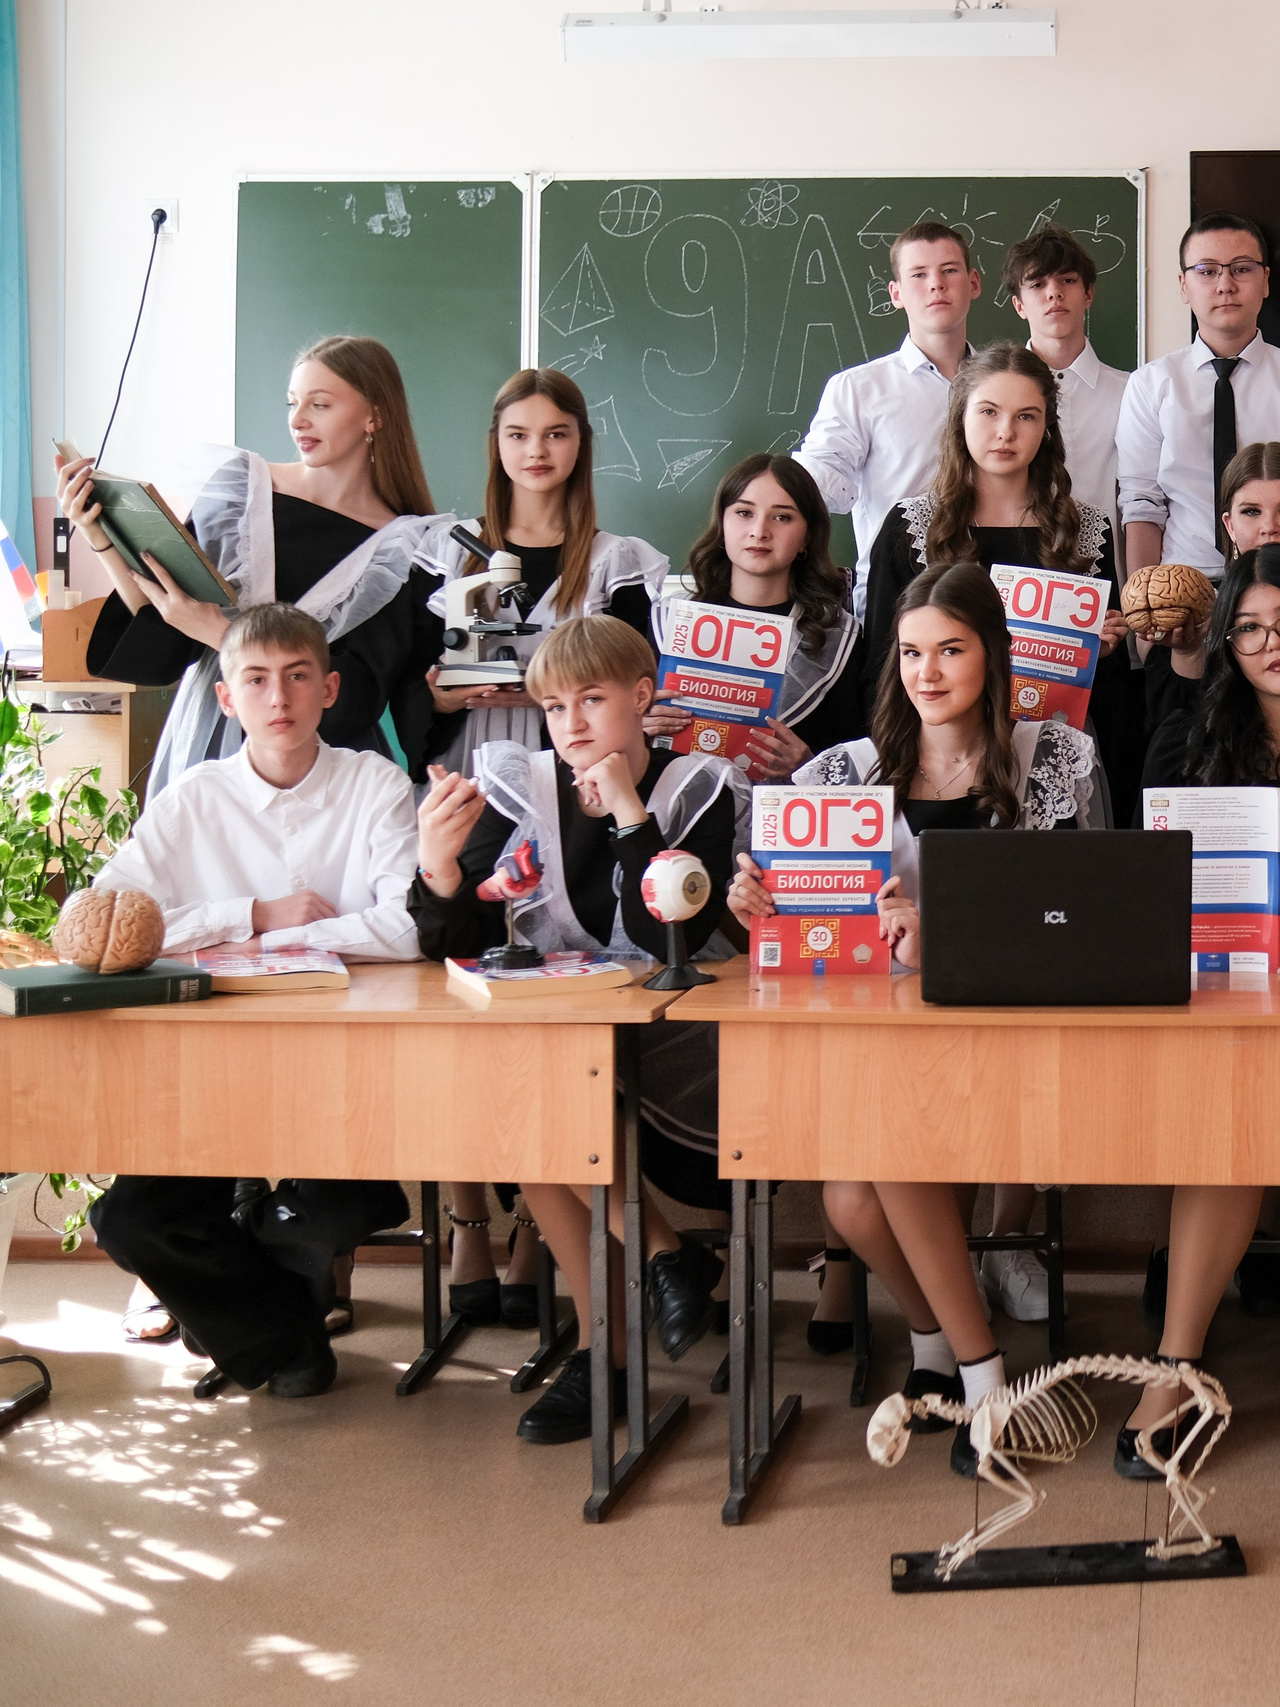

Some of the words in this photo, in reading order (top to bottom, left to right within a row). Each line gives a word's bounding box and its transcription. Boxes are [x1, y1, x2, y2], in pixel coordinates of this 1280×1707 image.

[1012, 577, 1100, 628] ОГЭ
[672, 624, 689, 654] 2025
[691, 615, 782, 668] ОГЭ
[1010, 640, 1075, 662] ИОЛОГИЯ
[679, 679, 757, 703] БИОЛОГИЯ
[1022, 691, 1036, 702] 30
[703, 733, 716, 744] 30
[762, 814, 777, 846] 2025
[783, 798, 884, 847] ОГЭ
[1153, 816, 1167, 831] 25
[778, 875, 864, 888] БИОЛОГИЯ
[812, 932, 827, 942] 30
